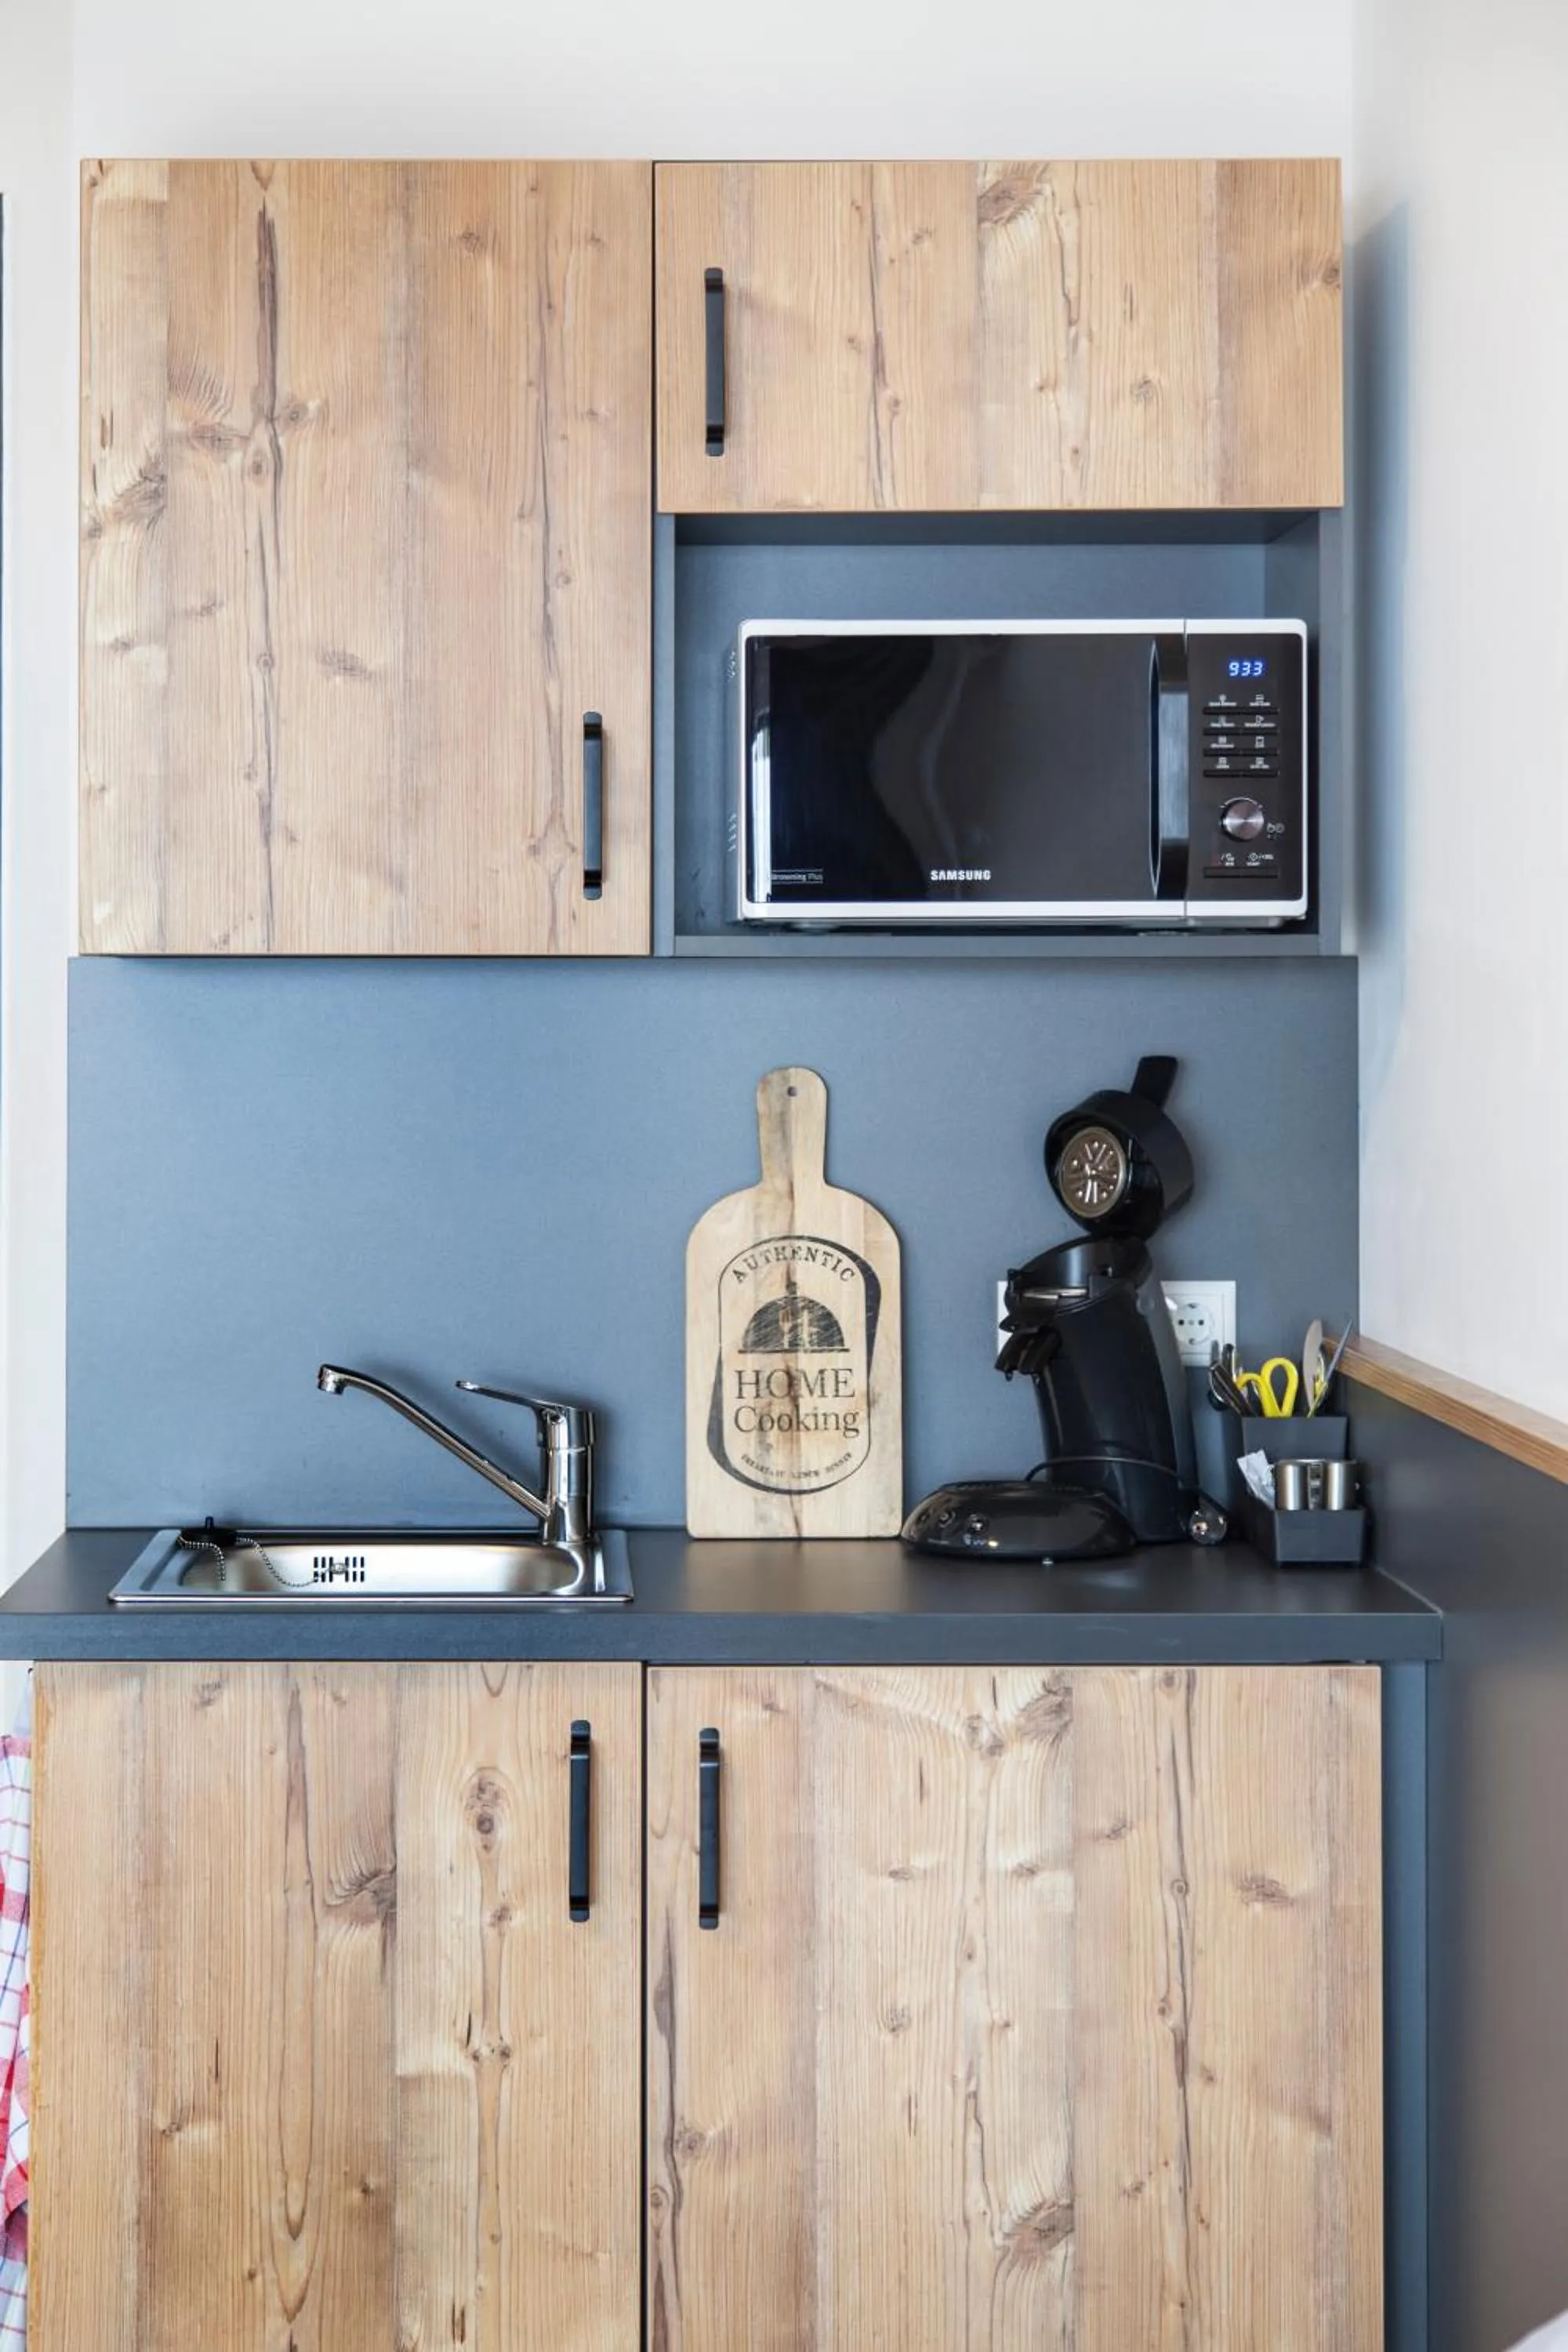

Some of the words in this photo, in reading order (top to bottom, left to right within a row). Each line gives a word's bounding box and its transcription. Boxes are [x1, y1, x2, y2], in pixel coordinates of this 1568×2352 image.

[930, 869, 992, 880] SAMSUNG
[732, 1244, 856, 1284] AUTHENTIC
[733, 1367, 856, 1399] HOME
[734, 1403, 860, 1439] Cooking
